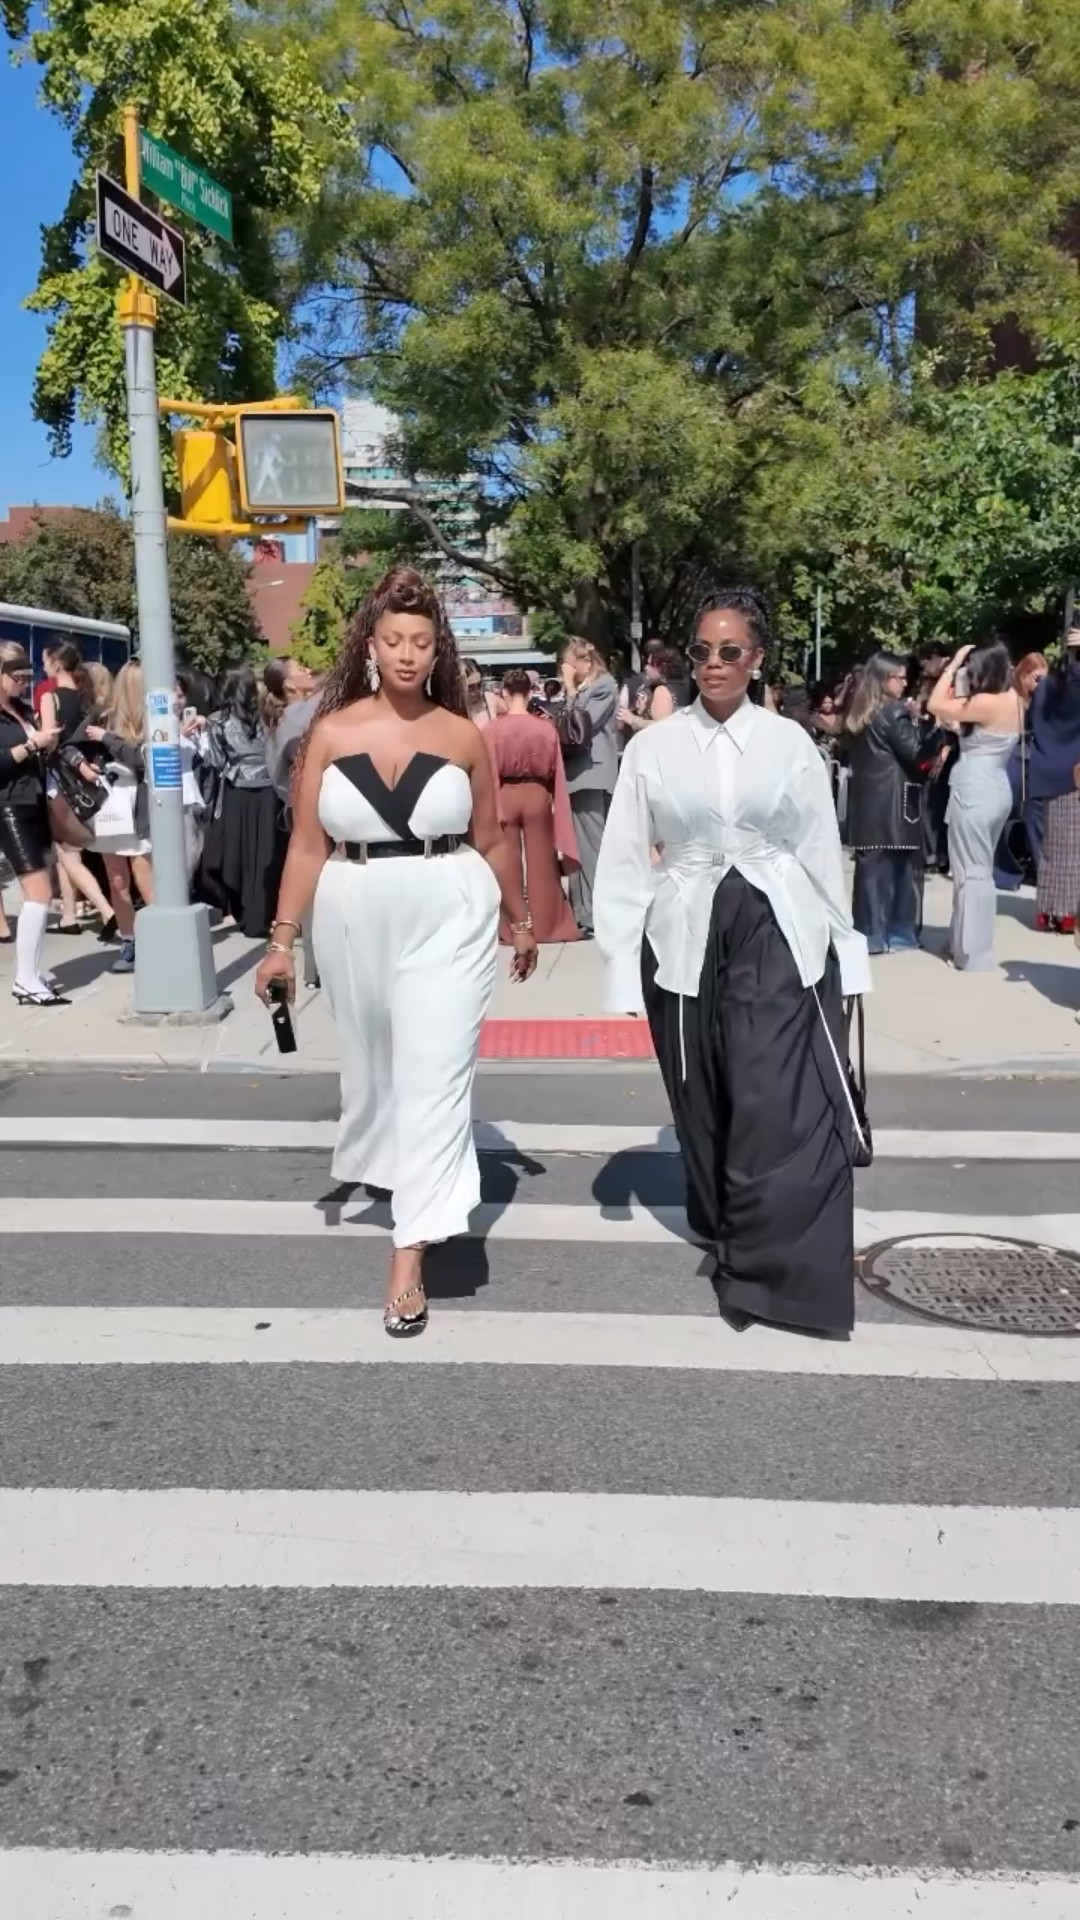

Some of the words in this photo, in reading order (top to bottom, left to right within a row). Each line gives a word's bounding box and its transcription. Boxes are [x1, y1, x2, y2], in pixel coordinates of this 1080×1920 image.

[141, 136, 174, 181] William
[113, 209, 139, 252] ONE
[149, 234, 174, 277] WAY
